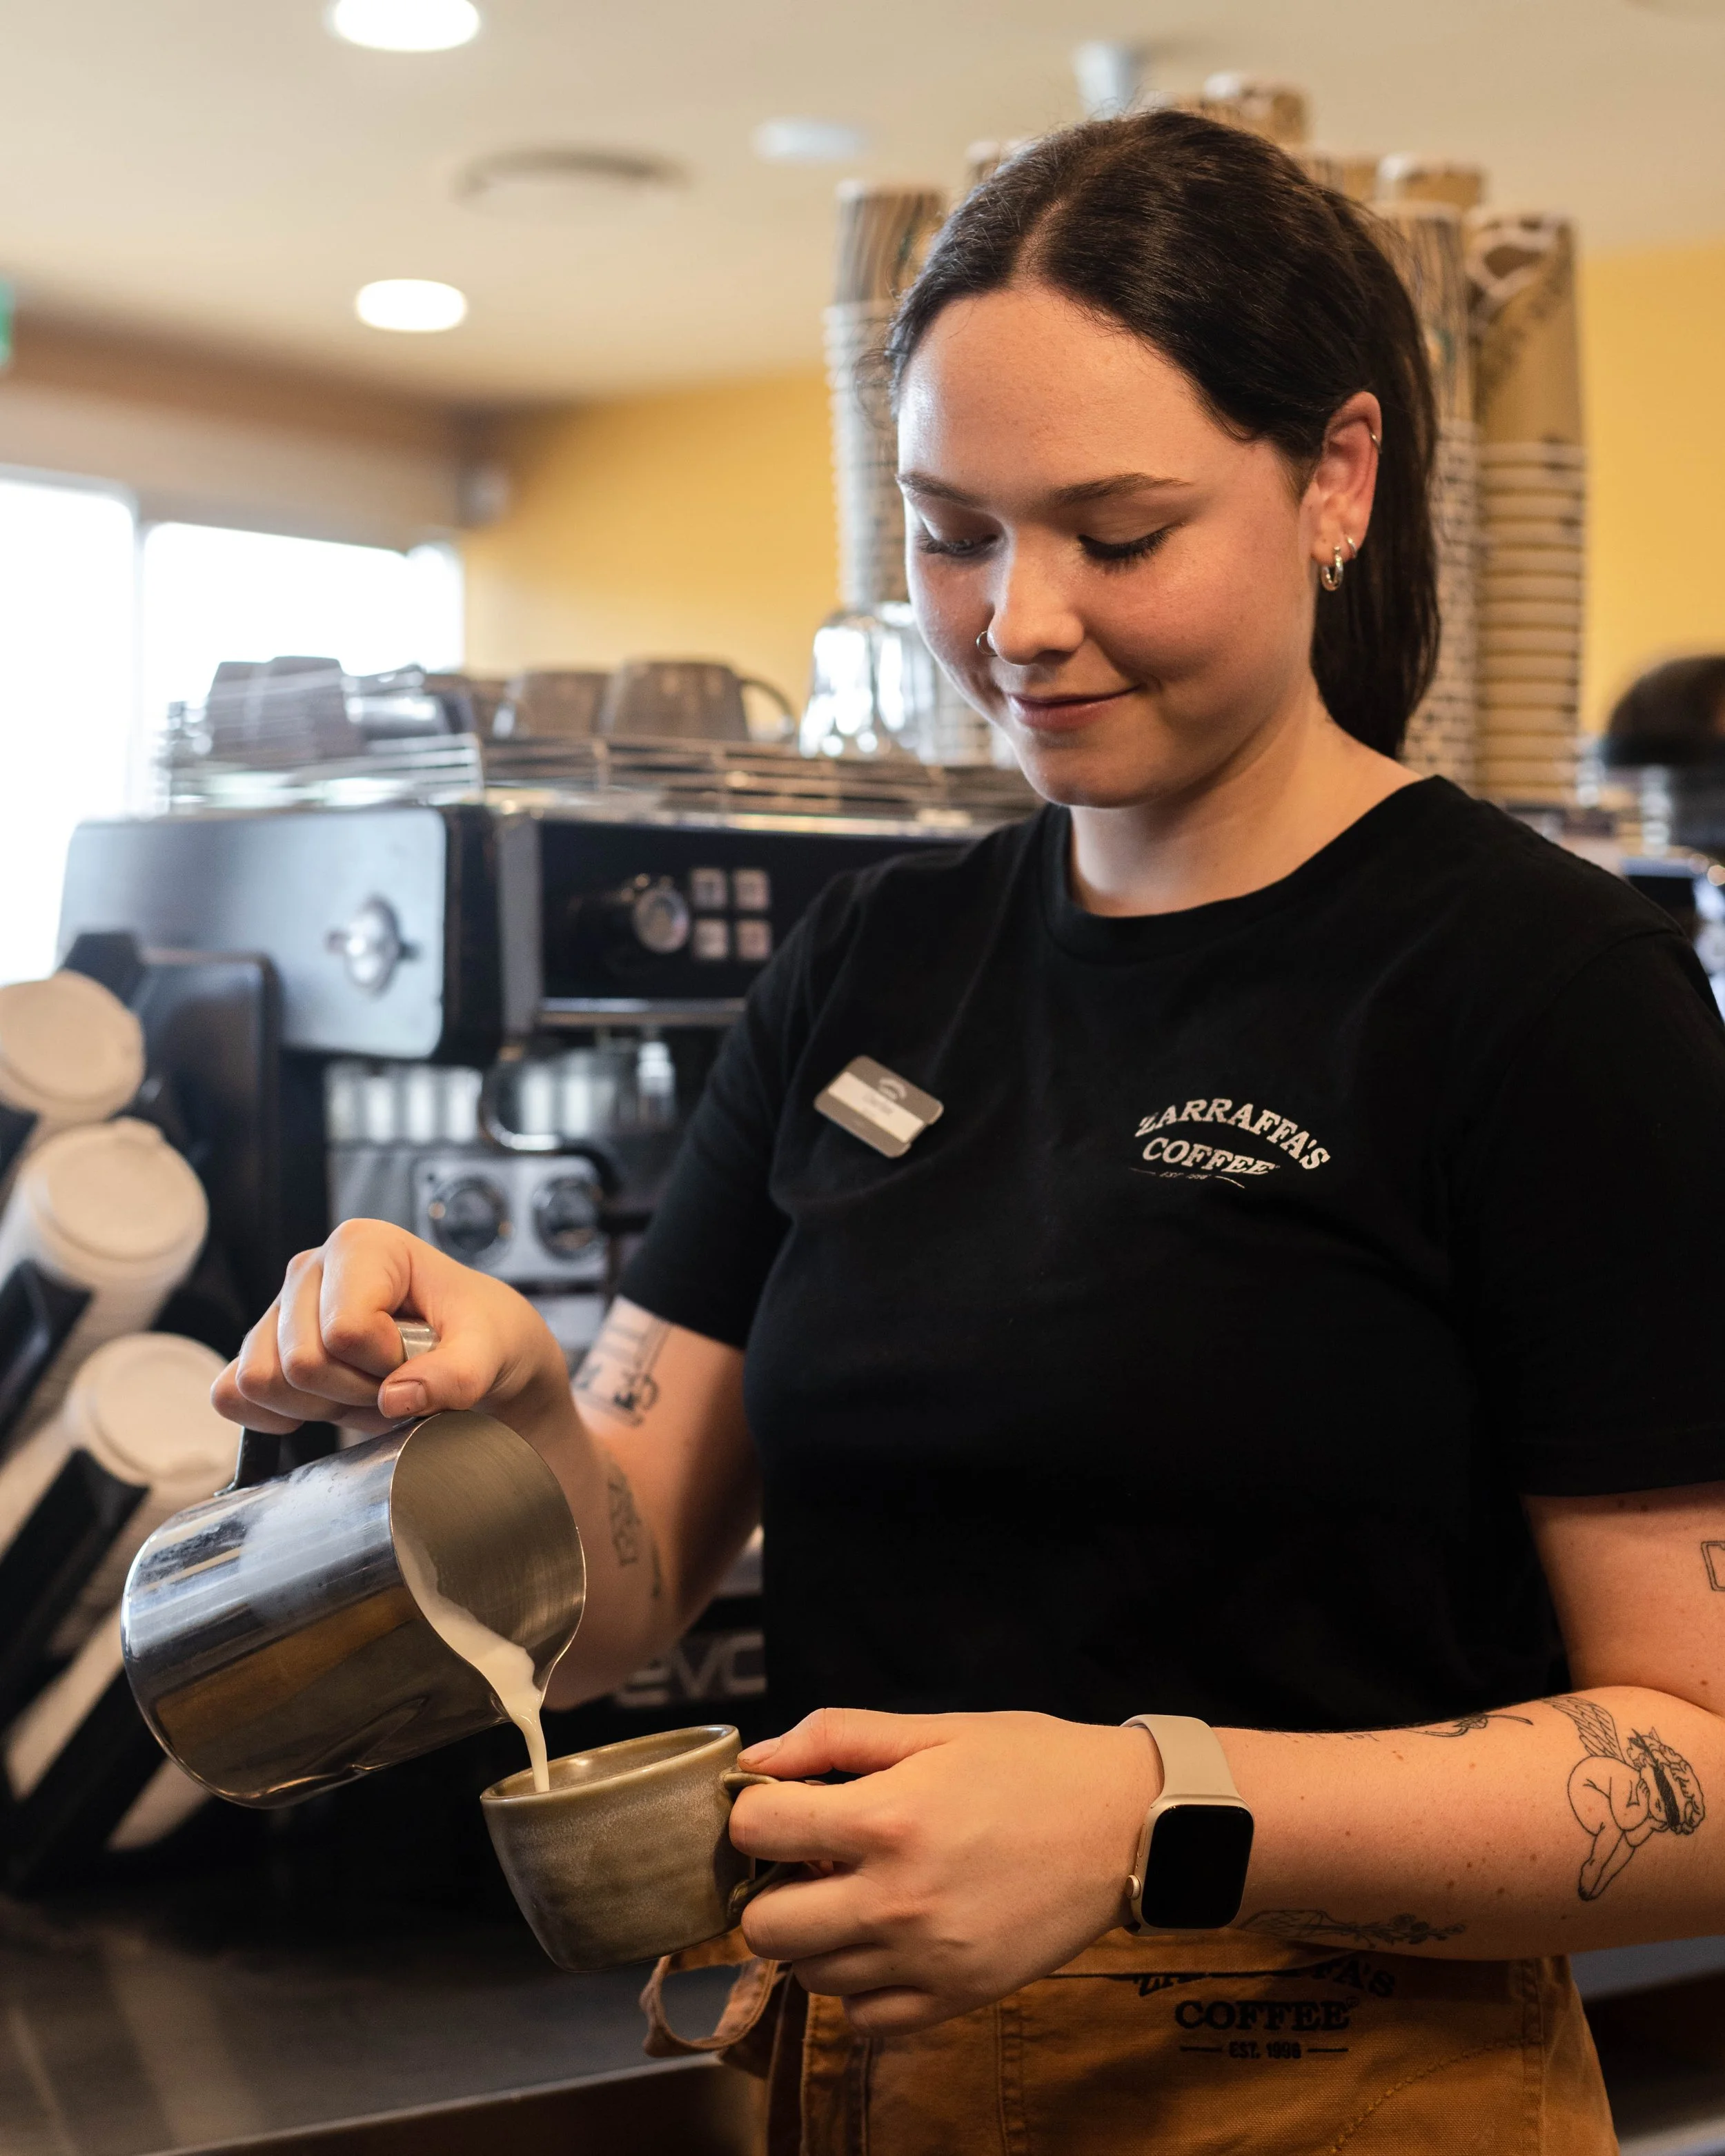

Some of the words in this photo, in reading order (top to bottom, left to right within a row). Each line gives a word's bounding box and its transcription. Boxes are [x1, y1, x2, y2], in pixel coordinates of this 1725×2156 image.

[1135, 1098, 1331, 1169] ZARRAFFA'S
[1143, 1138, 1276, 1175] COFFEE
[1174, 2001, 1350, 2030] COFFEE
[1229, 2041, 1260, 2059] EST.
